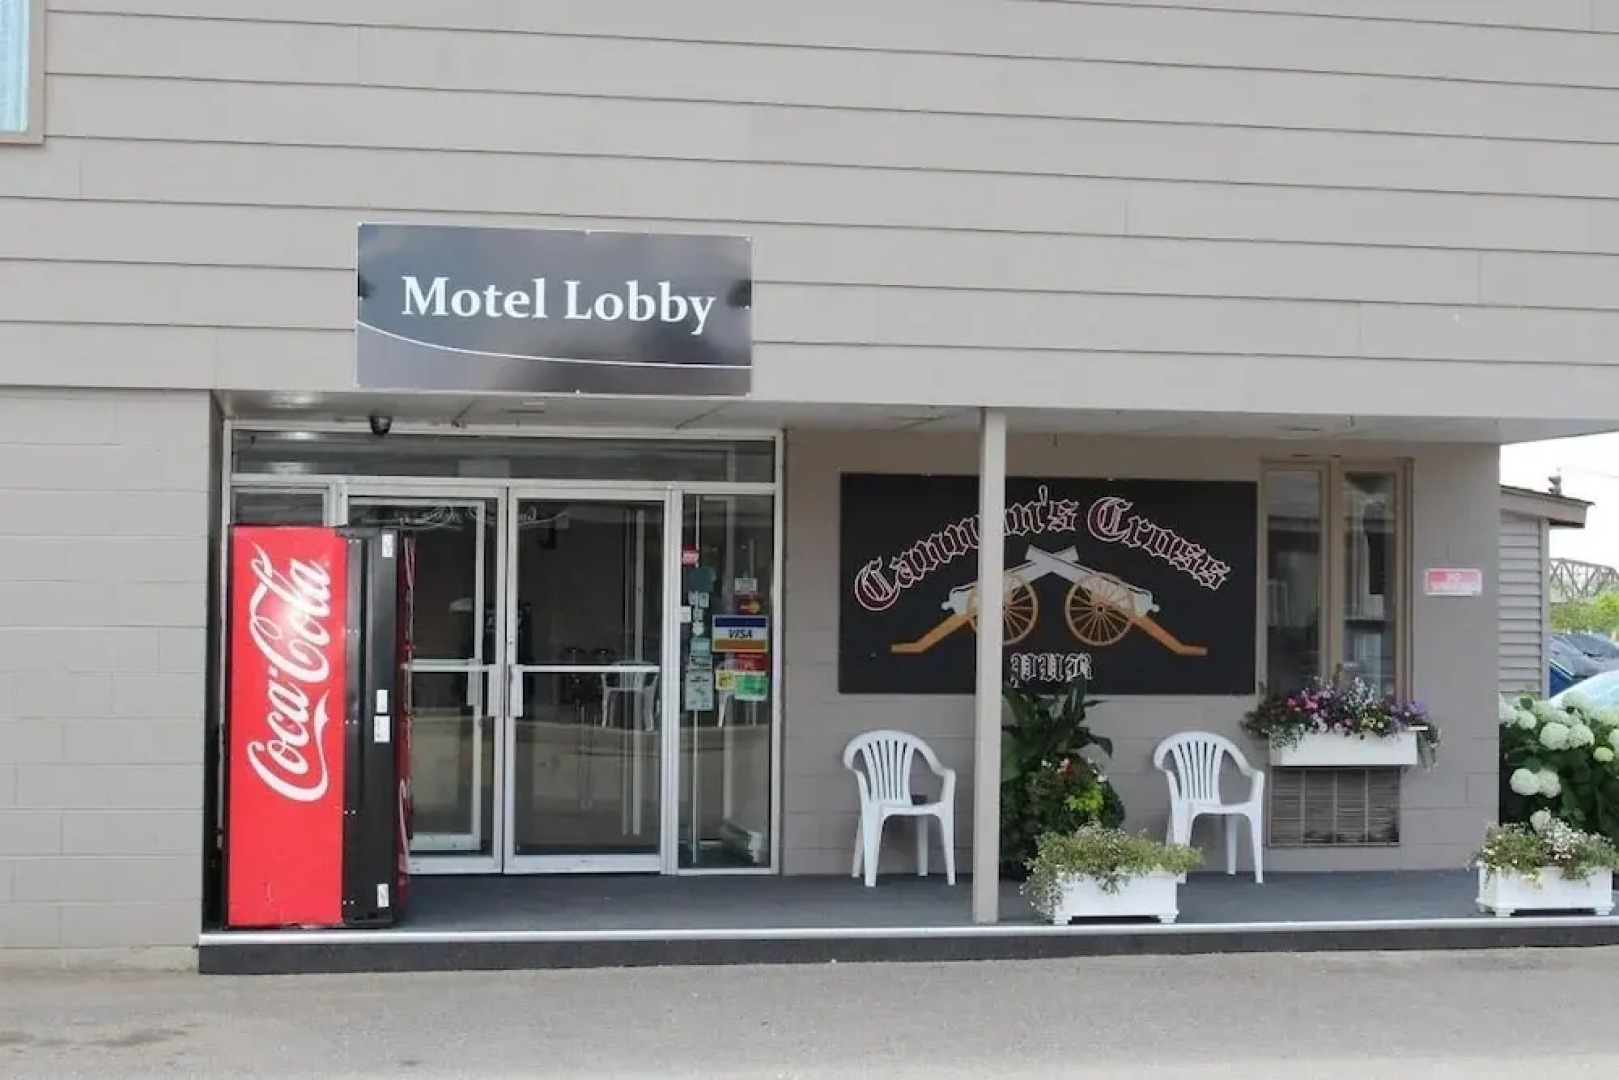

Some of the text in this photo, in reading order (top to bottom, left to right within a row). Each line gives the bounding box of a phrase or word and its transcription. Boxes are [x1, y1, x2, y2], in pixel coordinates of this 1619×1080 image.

[401, 275, 716, 335] Motel Lobby
[854, 485, 1232, 610] Cannn's Cross
[728, 629, 752, 639] VISA
